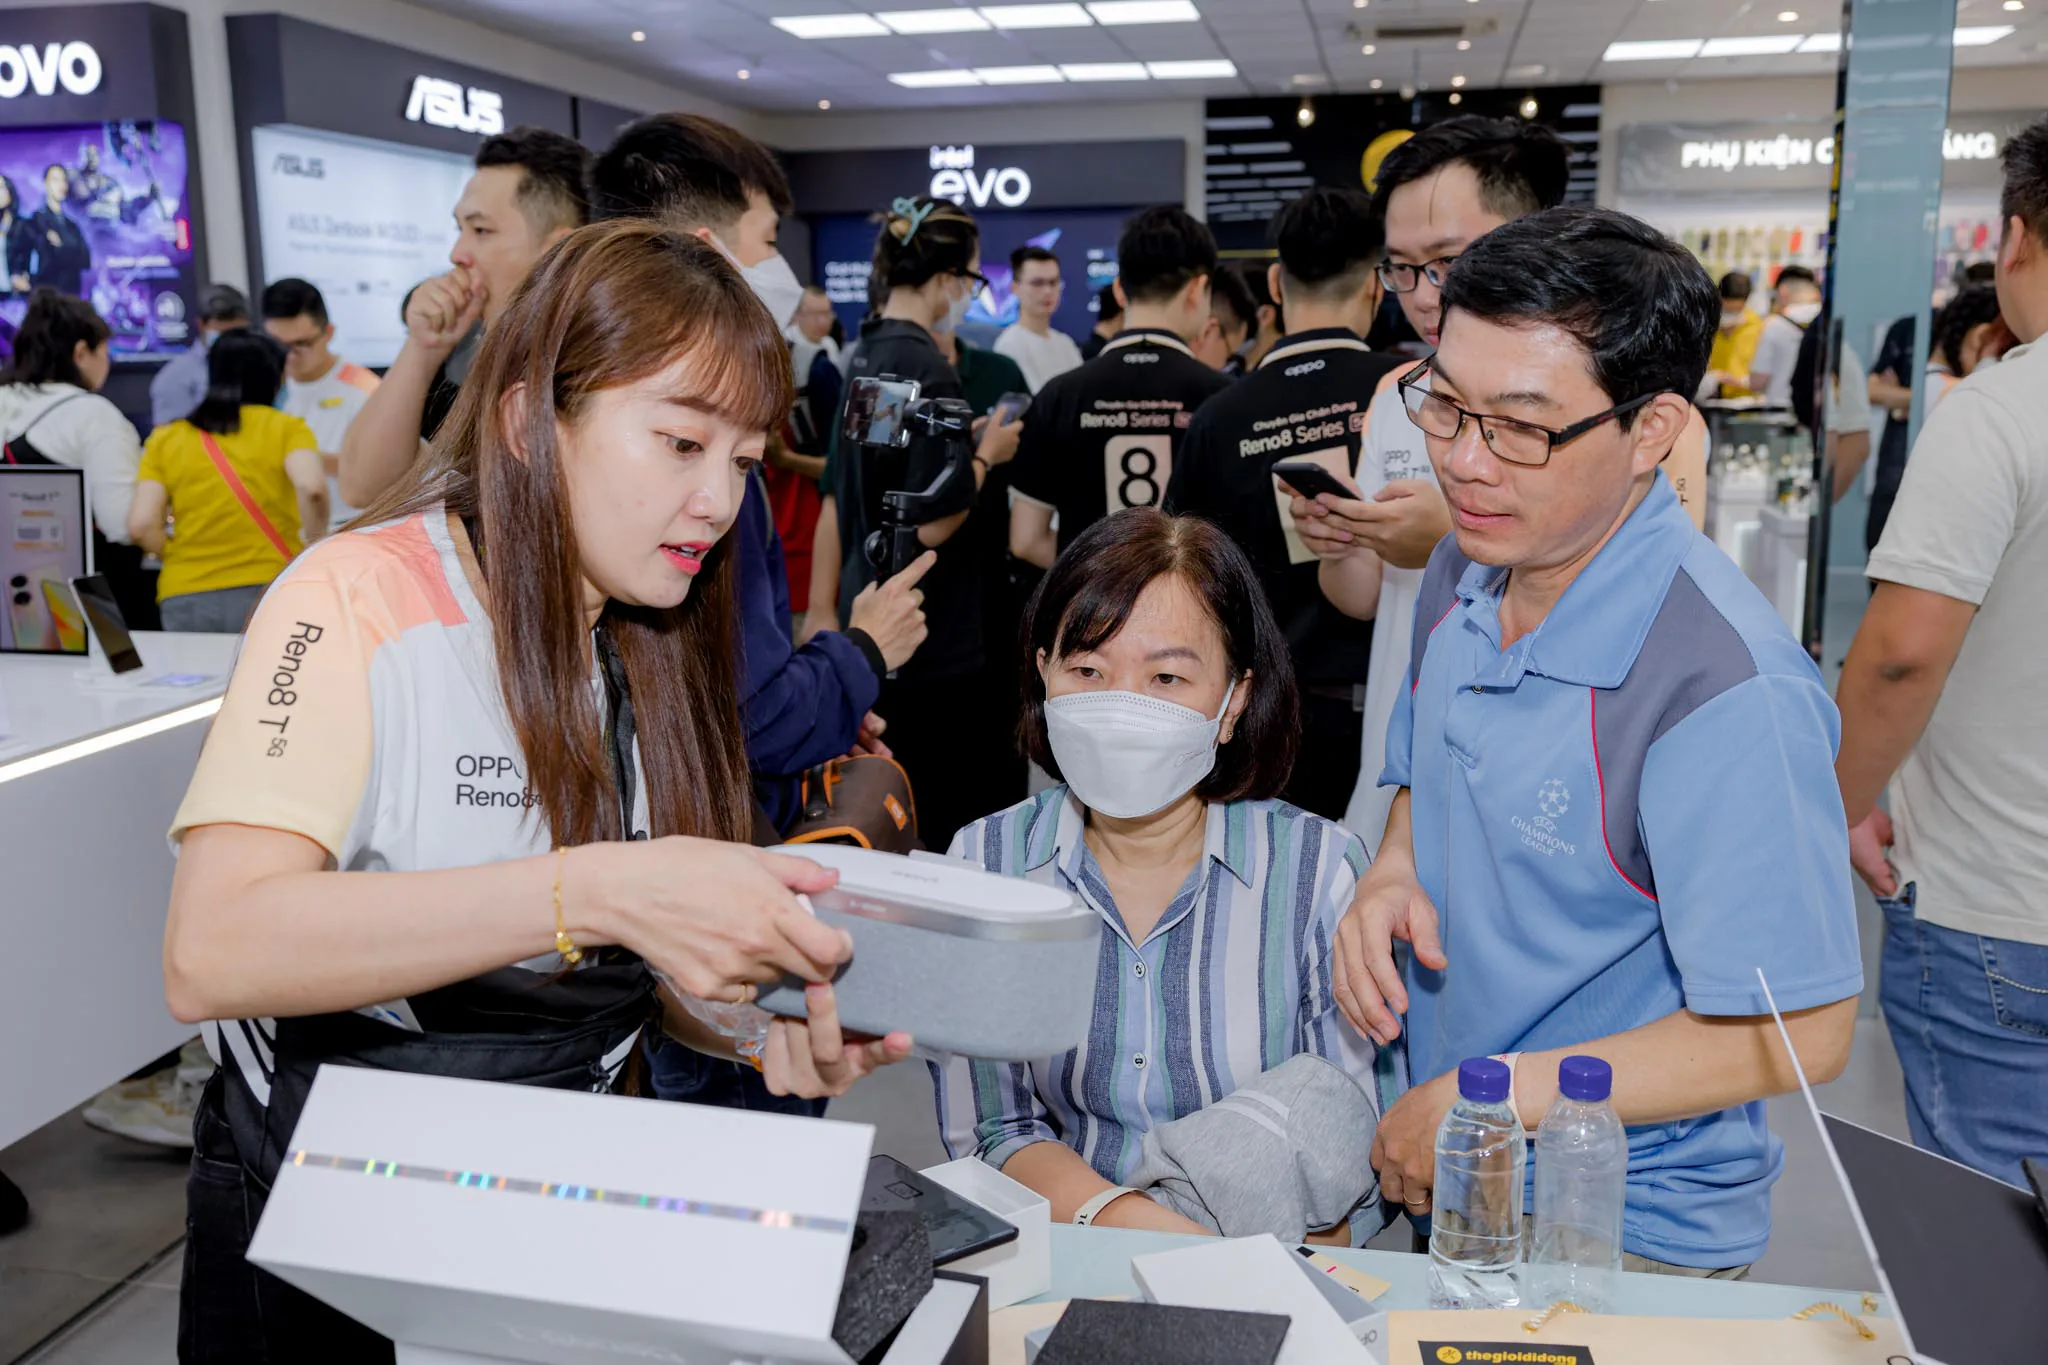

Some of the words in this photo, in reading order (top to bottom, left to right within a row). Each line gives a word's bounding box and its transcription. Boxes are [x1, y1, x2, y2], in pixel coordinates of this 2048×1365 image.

[405, 75, 504, 136] ASUS
[929, 144, 974, 169] intel
[1681, 140, 1741, 172] PHỤ
[1744, 133, 1812, 171] KIỆN
[273, 154, 326, 179] ASUS
[930, 167, 1032, 207] evo
[1284, 359, 1326, 376] oppo
[1080, 411, 1128, 429] Reno8
[1129, 411, 1171, 428] Series
[1239, 429, 1293, 458] Reno8
[1295, 420, 1345, 444] Series
[1119, 447, 1160, 508] 8
[267, 620, 324, 706] Reno8
[258, 715, 290, 734] T
[266, 737, 288, 758] 5G
[456, 754, 522, 780] OPP
[1511, 815, 1576, 855] CHAMPIONS
[1521, 834, 1556, 857] LEAGUE
[1465, 1351, 1577, 1365] thegioididong
